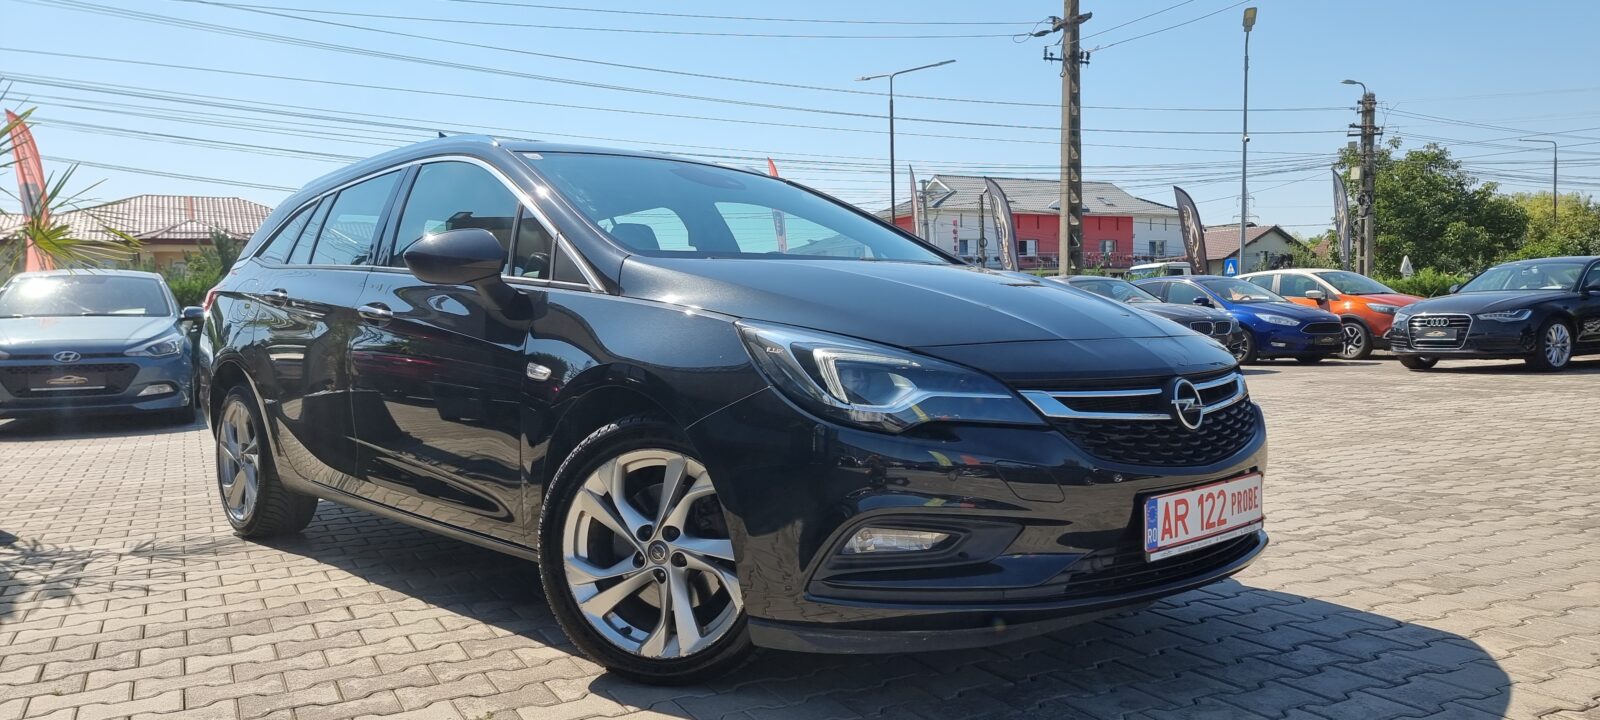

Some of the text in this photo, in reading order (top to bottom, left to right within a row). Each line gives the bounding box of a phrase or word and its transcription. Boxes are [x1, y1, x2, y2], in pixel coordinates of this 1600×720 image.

[1161, 498, 1189, 541] AR
[1198, 490, 1227, 531] 122
[1231, 487, 1258, 515] PROBE
[1147, 528, 1157, 544] RO
